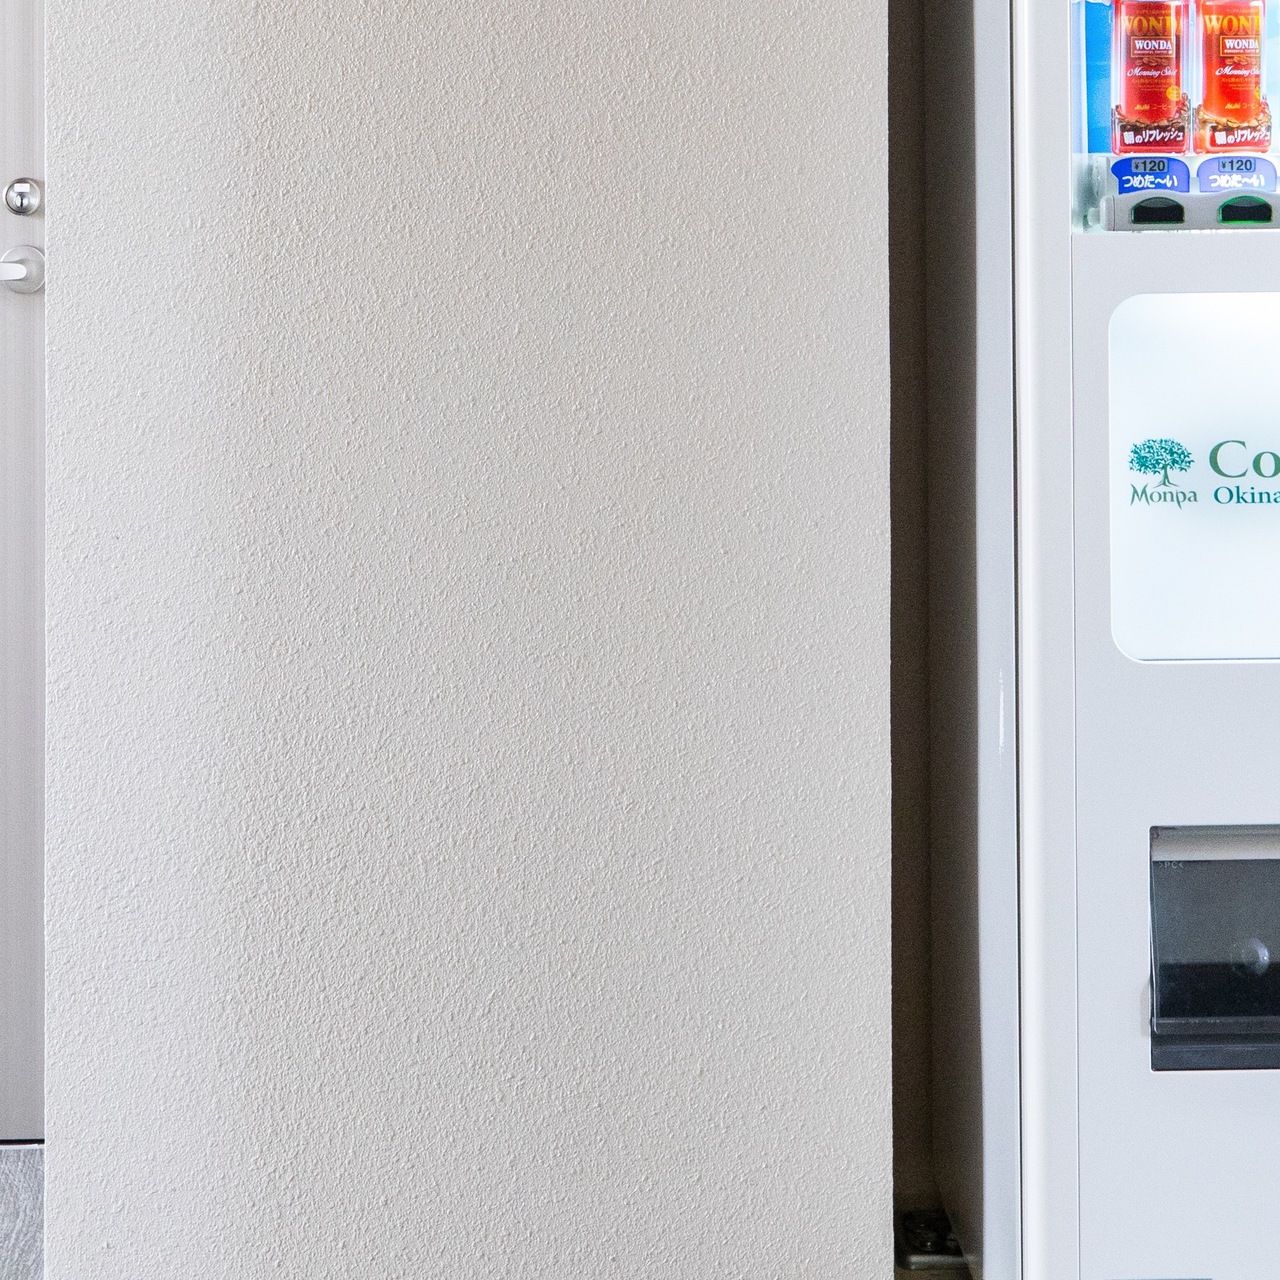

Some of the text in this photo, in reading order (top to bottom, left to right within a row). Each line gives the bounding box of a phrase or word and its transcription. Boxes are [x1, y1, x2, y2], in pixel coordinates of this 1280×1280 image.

[1135, 40, 1172, 50] WONDA
[1224, 39, 1259, 50] WONDA
[1134, 160, 1166, 172] ¥120
[1221, 159, 1253, 171] ¥120
[1122, 174, 1178, 187] つめた〜い
[1130, 483, 1198, 510] Monpa
